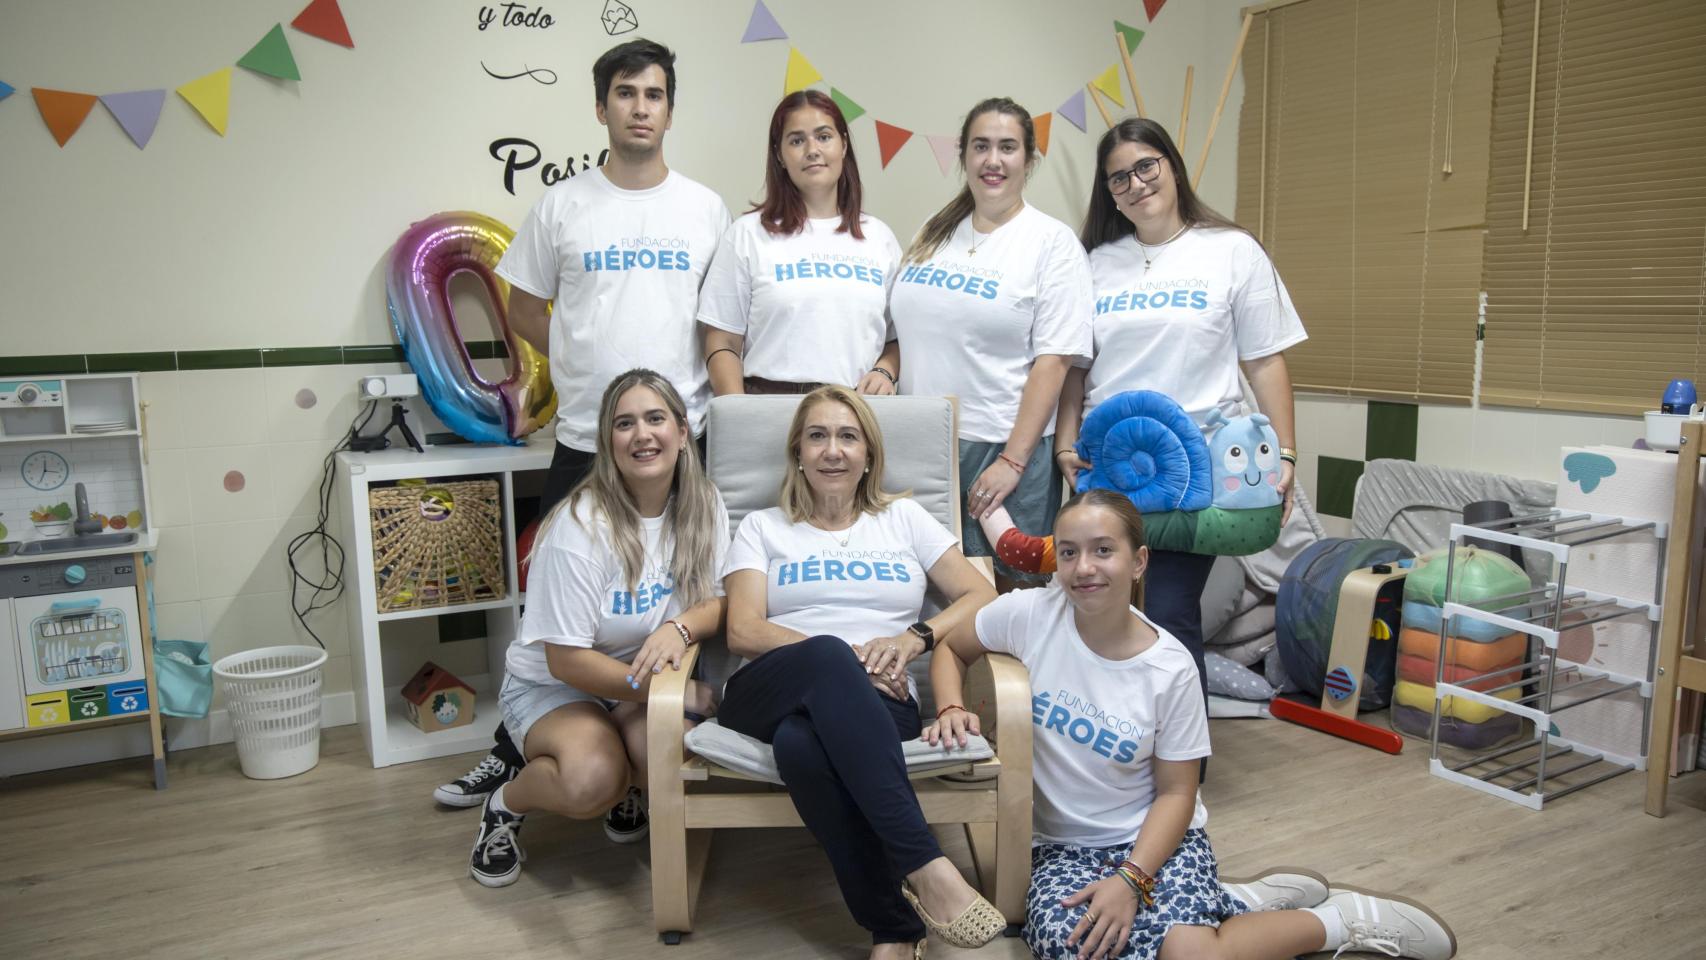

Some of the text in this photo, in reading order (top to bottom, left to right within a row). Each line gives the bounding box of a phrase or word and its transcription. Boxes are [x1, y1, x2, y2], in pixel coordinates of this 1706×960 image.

[478, 6, 495, 31] y
[621, 236, 690, 249] FUNDACIÓN
[584, 245, 690, 272] HÉROES
[775, 259, 883, 286] HÉROES
[901, 264, 999, 300] HÉROES
[1096, 290, 1208, 314] HÉROES
[822, 549, 903, 561] FUNDACIÓN
[778, 555, 911, 585] HÉROES
[612, 572, 673, 615] HÉR
[1032, 691, 1138, 763] ÉROES
[1057, 690, 1145, 740] FUNDACIÓN
